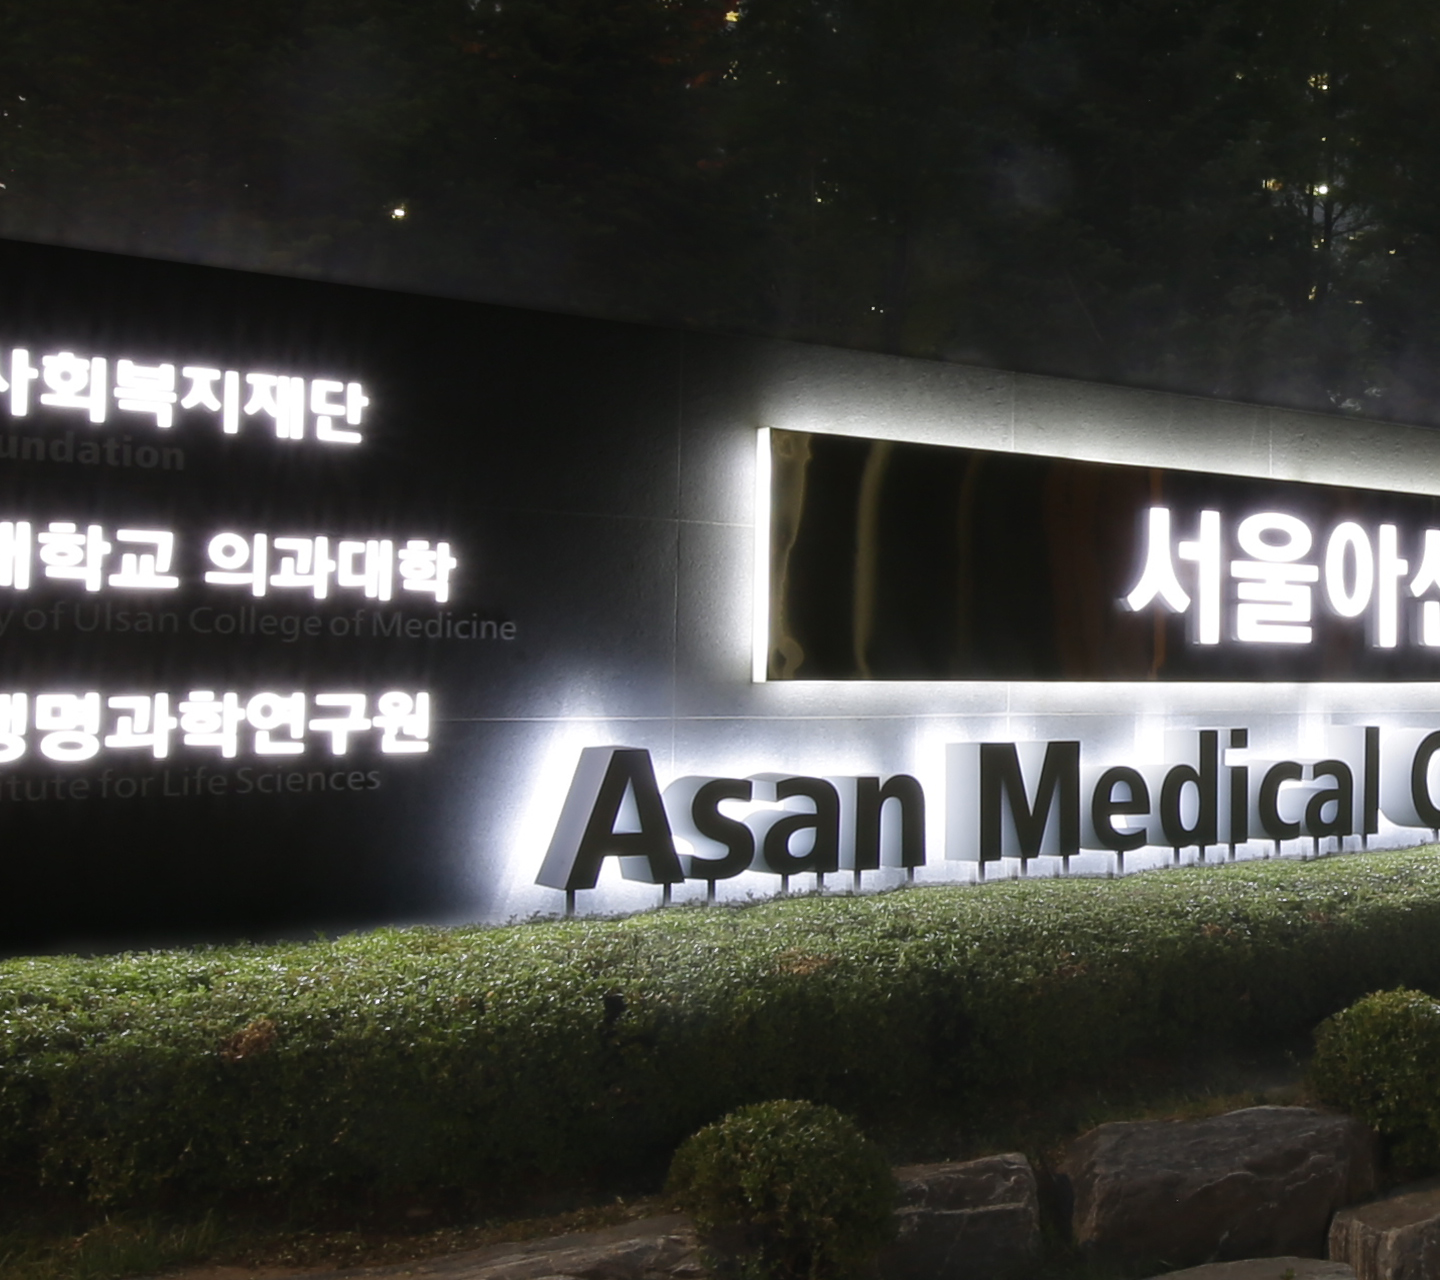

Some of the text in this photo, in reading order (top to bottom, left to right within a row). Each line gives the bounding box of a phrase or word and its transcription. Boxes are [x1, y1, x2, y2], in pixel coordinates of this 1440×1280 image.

[204, 532, 457, 603] 의과대학
[23, 602, 67, 631] of
[74, 601, 179, 633] Ulsan
[189, 606, 323, 643] College
[329, 609, 368, 637] of
[372, 611, 517, 641] Medicine
[99, 770, 155, 799] for
[162, 767, 228, 797] Life
[235, 766, 381, 795] Sciences
[558, 747, 926, 891] Asan
[978, 726, 1380, 862] Medical
